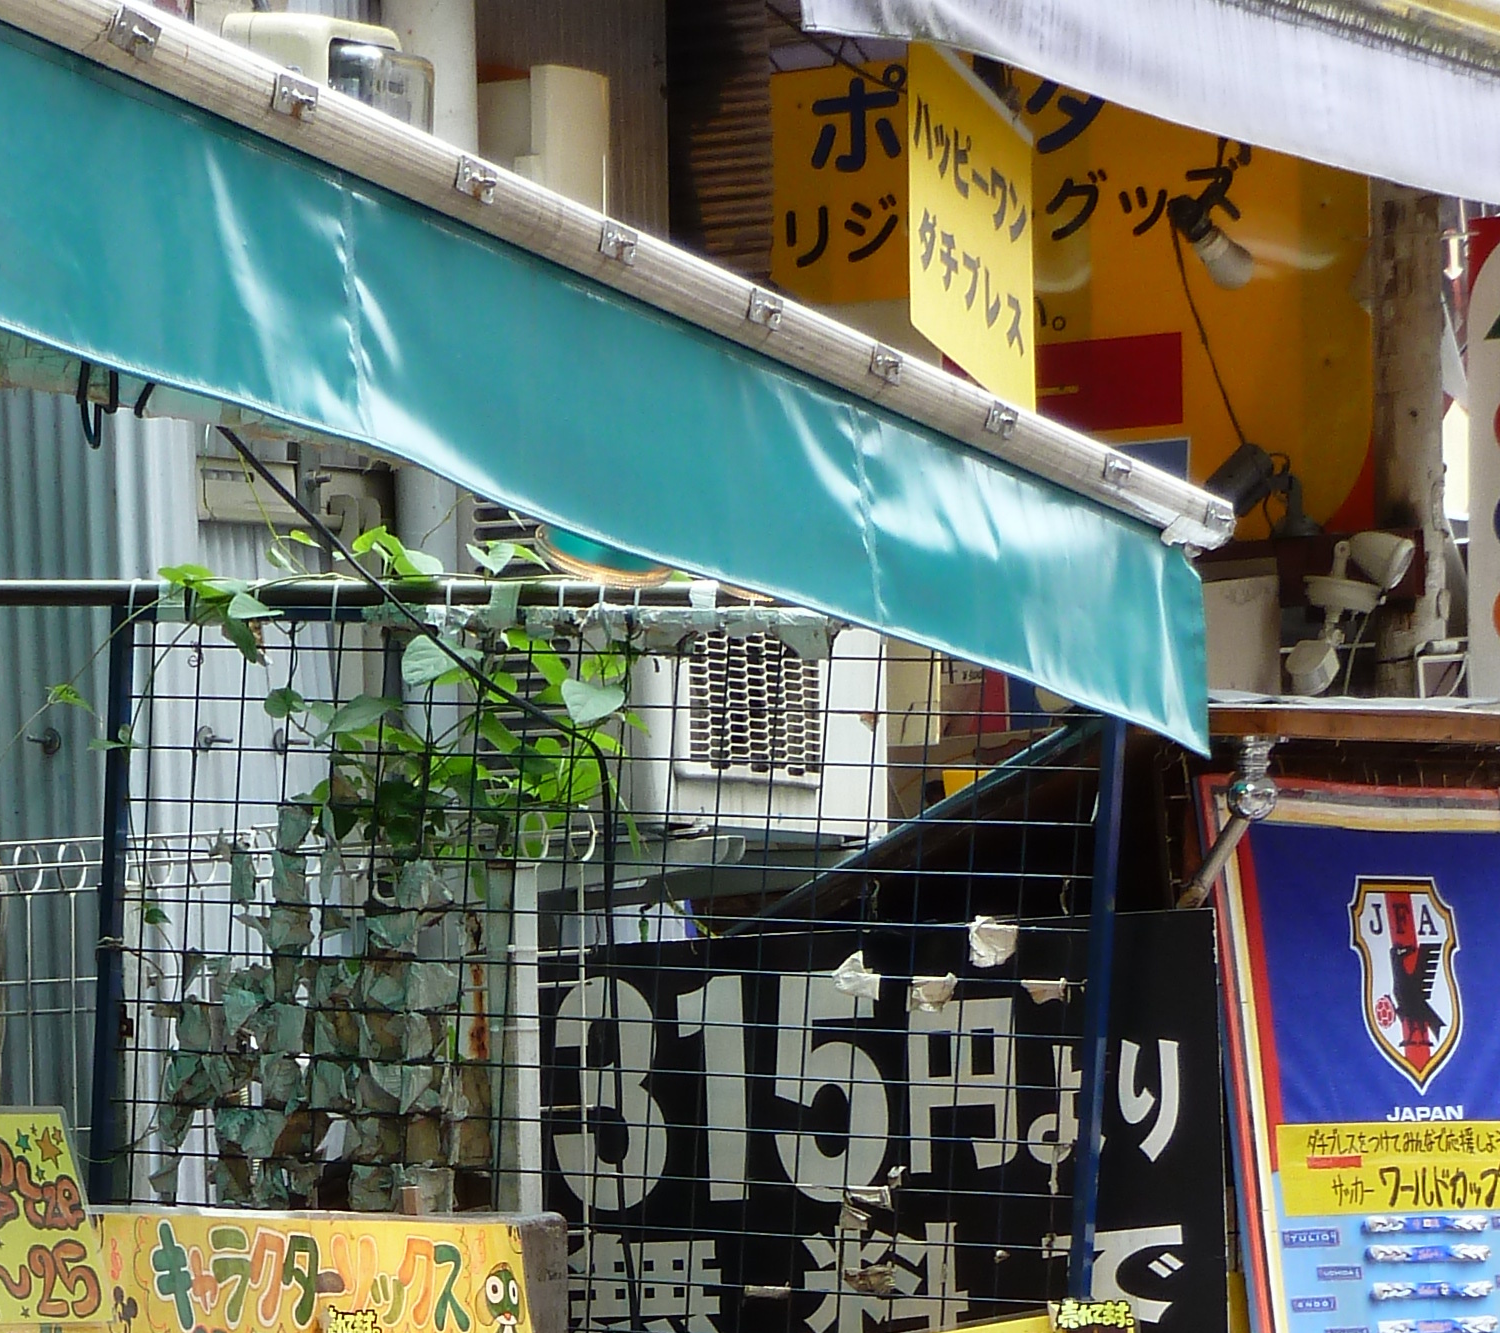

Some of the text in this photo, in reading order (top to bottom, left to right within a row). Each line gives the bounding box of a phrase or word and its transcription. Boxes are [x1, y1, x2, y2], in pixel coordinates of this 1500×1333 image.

[913, 95, 1027, 243] ハッピーワン
[1368, 902, 1438, 937] JFA
[1386, 1105, 1463, 1121] JAPAN
